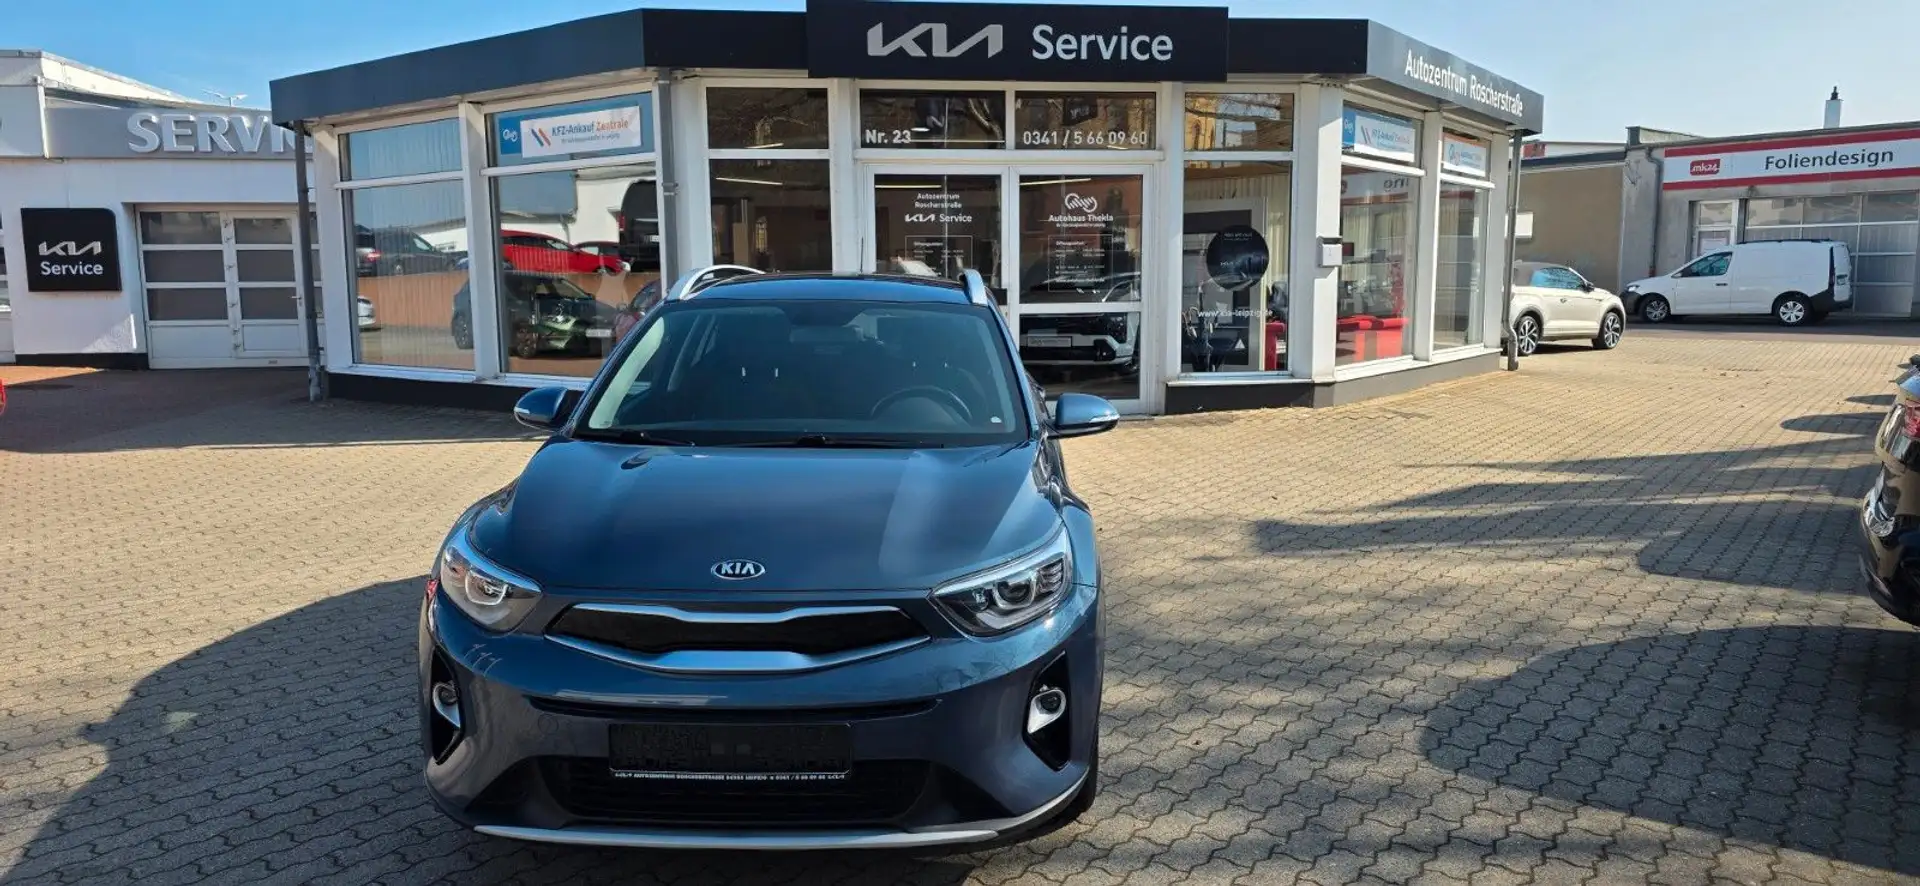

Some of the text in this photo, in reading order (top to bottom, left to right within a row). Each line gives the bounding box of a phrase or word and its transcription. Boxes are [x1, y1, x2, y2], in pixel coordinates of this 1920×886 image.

[867, 22, 1173, 61] KIA Service
[1404, 48, 1523, 117] Autozentrum Roscherstraße
[552, 118, 629, 137] KFZ-Ankauf Zentrale
[865, 129, 912, 144] Nr. 23
[1023, 131, 1148, 146] 0341 / 5 66 09 60
[1765, 148, 1893, 171] Foliendesign
[904, 213, 972, 222] KIA Service
[1088, 214, 1113, 222] Thekla
[38, 241, 102, 256] KIA
[40, 260, 104, 275] Service
[721, 562, 756, 574] KIA
